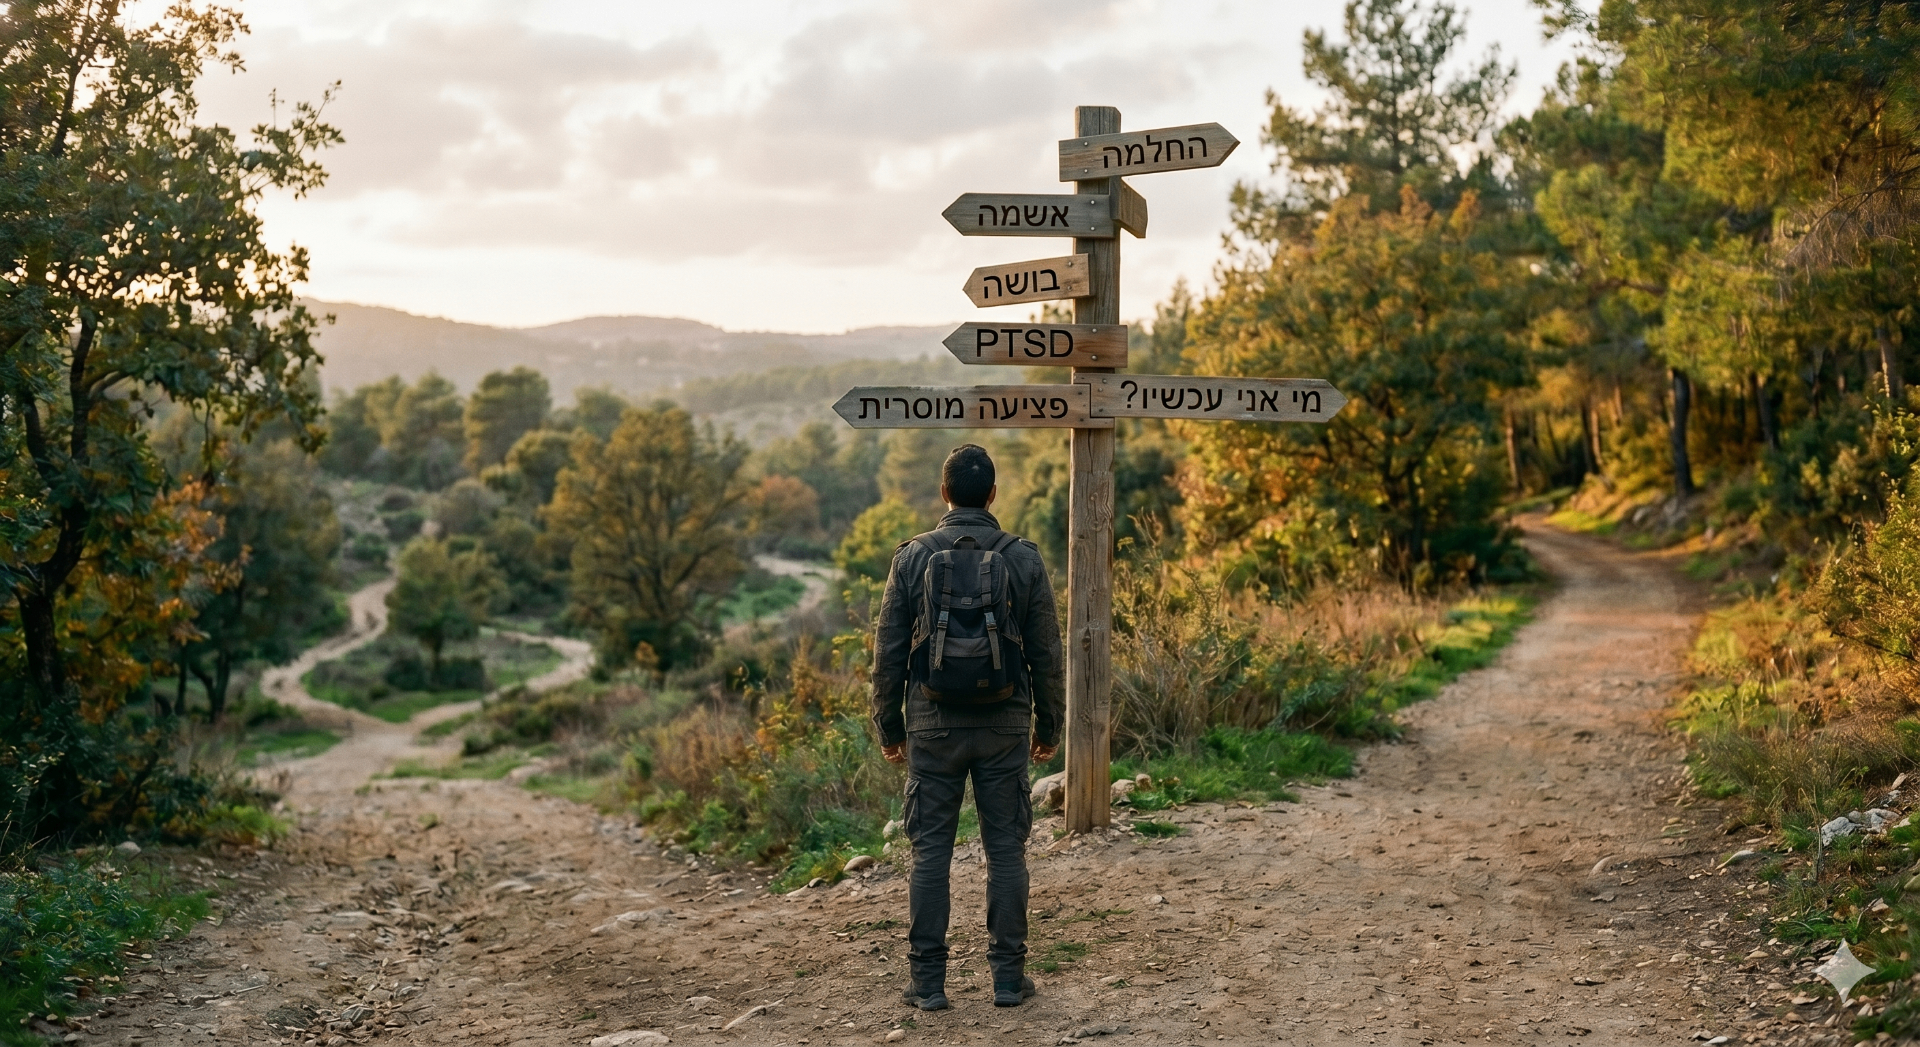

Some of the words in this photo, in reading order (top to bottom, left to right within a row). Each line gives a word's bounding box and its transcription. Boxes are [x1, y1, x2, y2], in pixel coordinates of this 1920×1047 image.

[1102, 134, 1208, 169] החלמה
[977, 203, 1070, 228] אשמה
[983, 268, 1061, 299] בושה
[976, 328, 1074, 358] PTSD
[858, 396, 965, 420] מוסרית
[978, 396, 1069, 421] פציעה
[1120, 380, 1223, 413] עכשיו?
[1237, 388, 1279, 413] אני
[1291, 389, 1322, 414] מי
